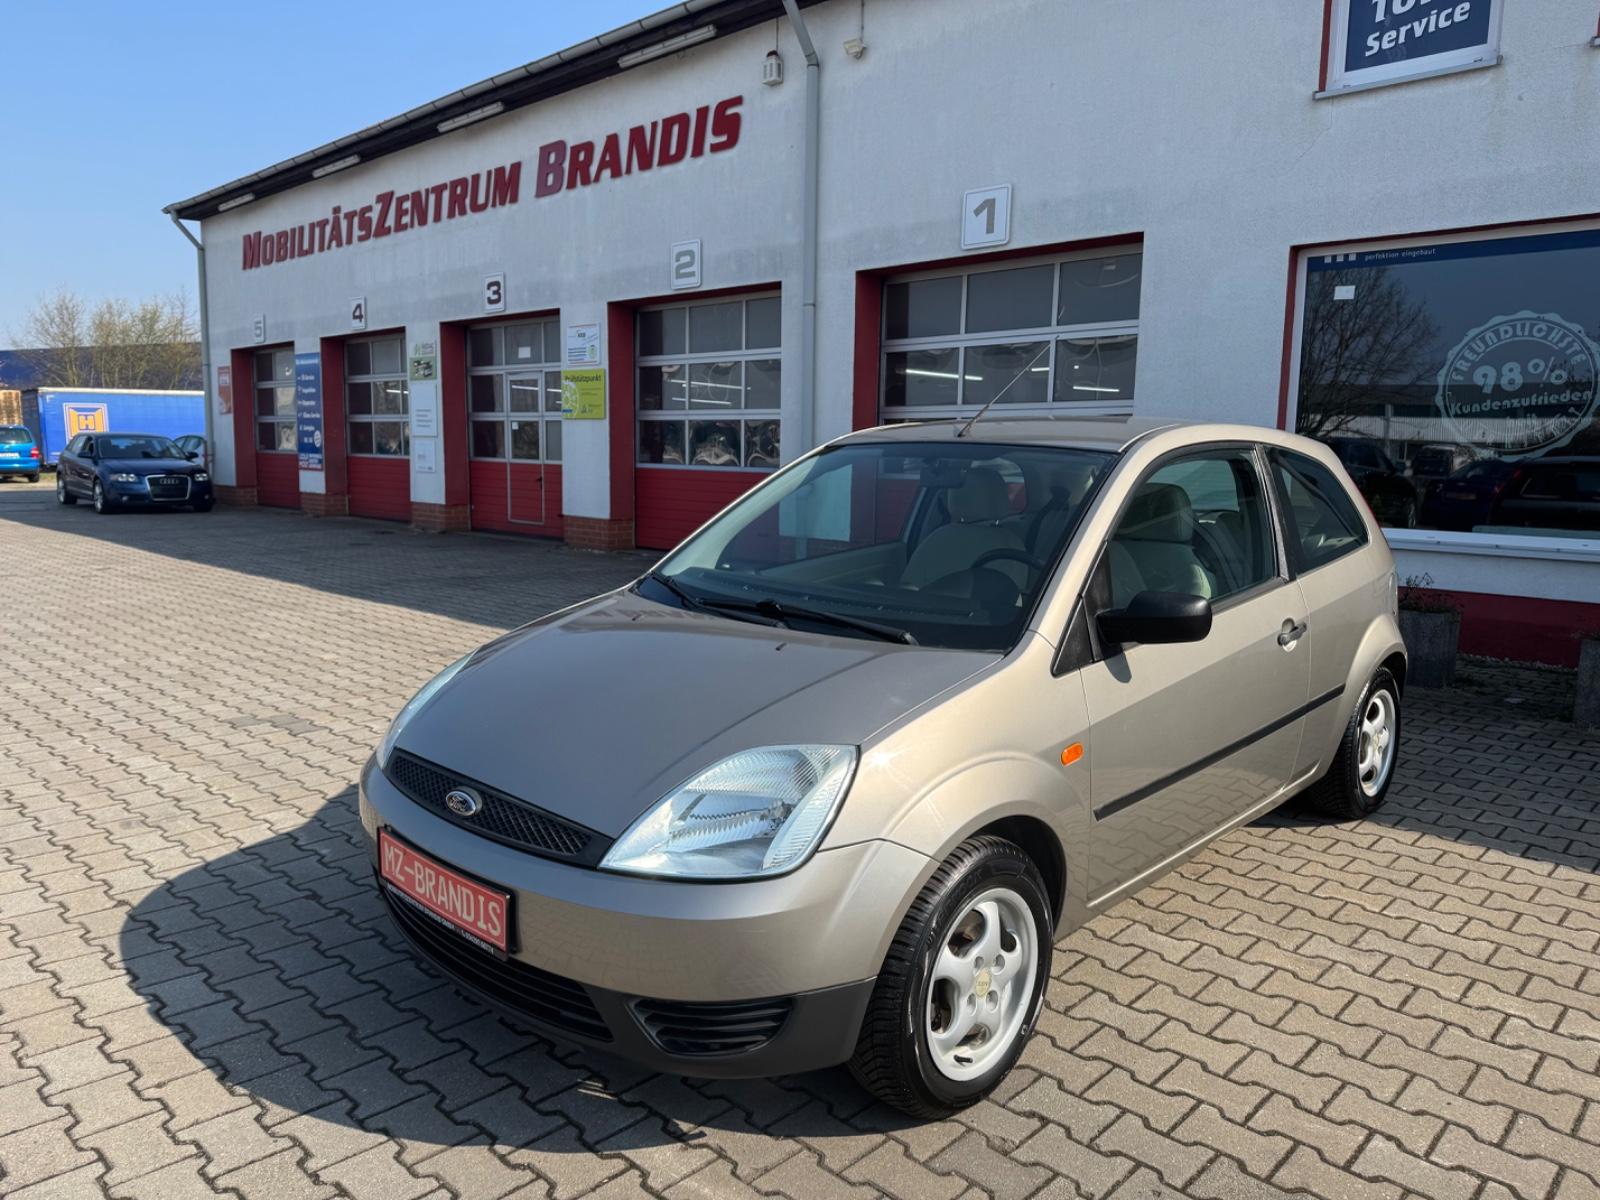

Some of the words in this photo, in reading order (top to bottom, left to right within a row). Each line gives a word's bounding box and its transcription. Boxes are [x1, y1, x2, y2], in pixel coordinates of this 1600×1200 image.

[1365, 1, 1471, 57] Service
[535, 95, 745, 199] BRANDIS
[973, 198, 996, 234] 1
[675, 250, 696, 280] 2
[1364, 251, 1399, 262] perfektion
[1401, 248, 1437, 259] eingebaut
[486, 281, 502, 304] 3
[254, 321, 262, 337] 5
[352, 303, 363, 322] 4
[1451, 321, 1587, 382] FREUNDLICHSTE
[384, 840, 501, 937] MZ-BRANDIS
